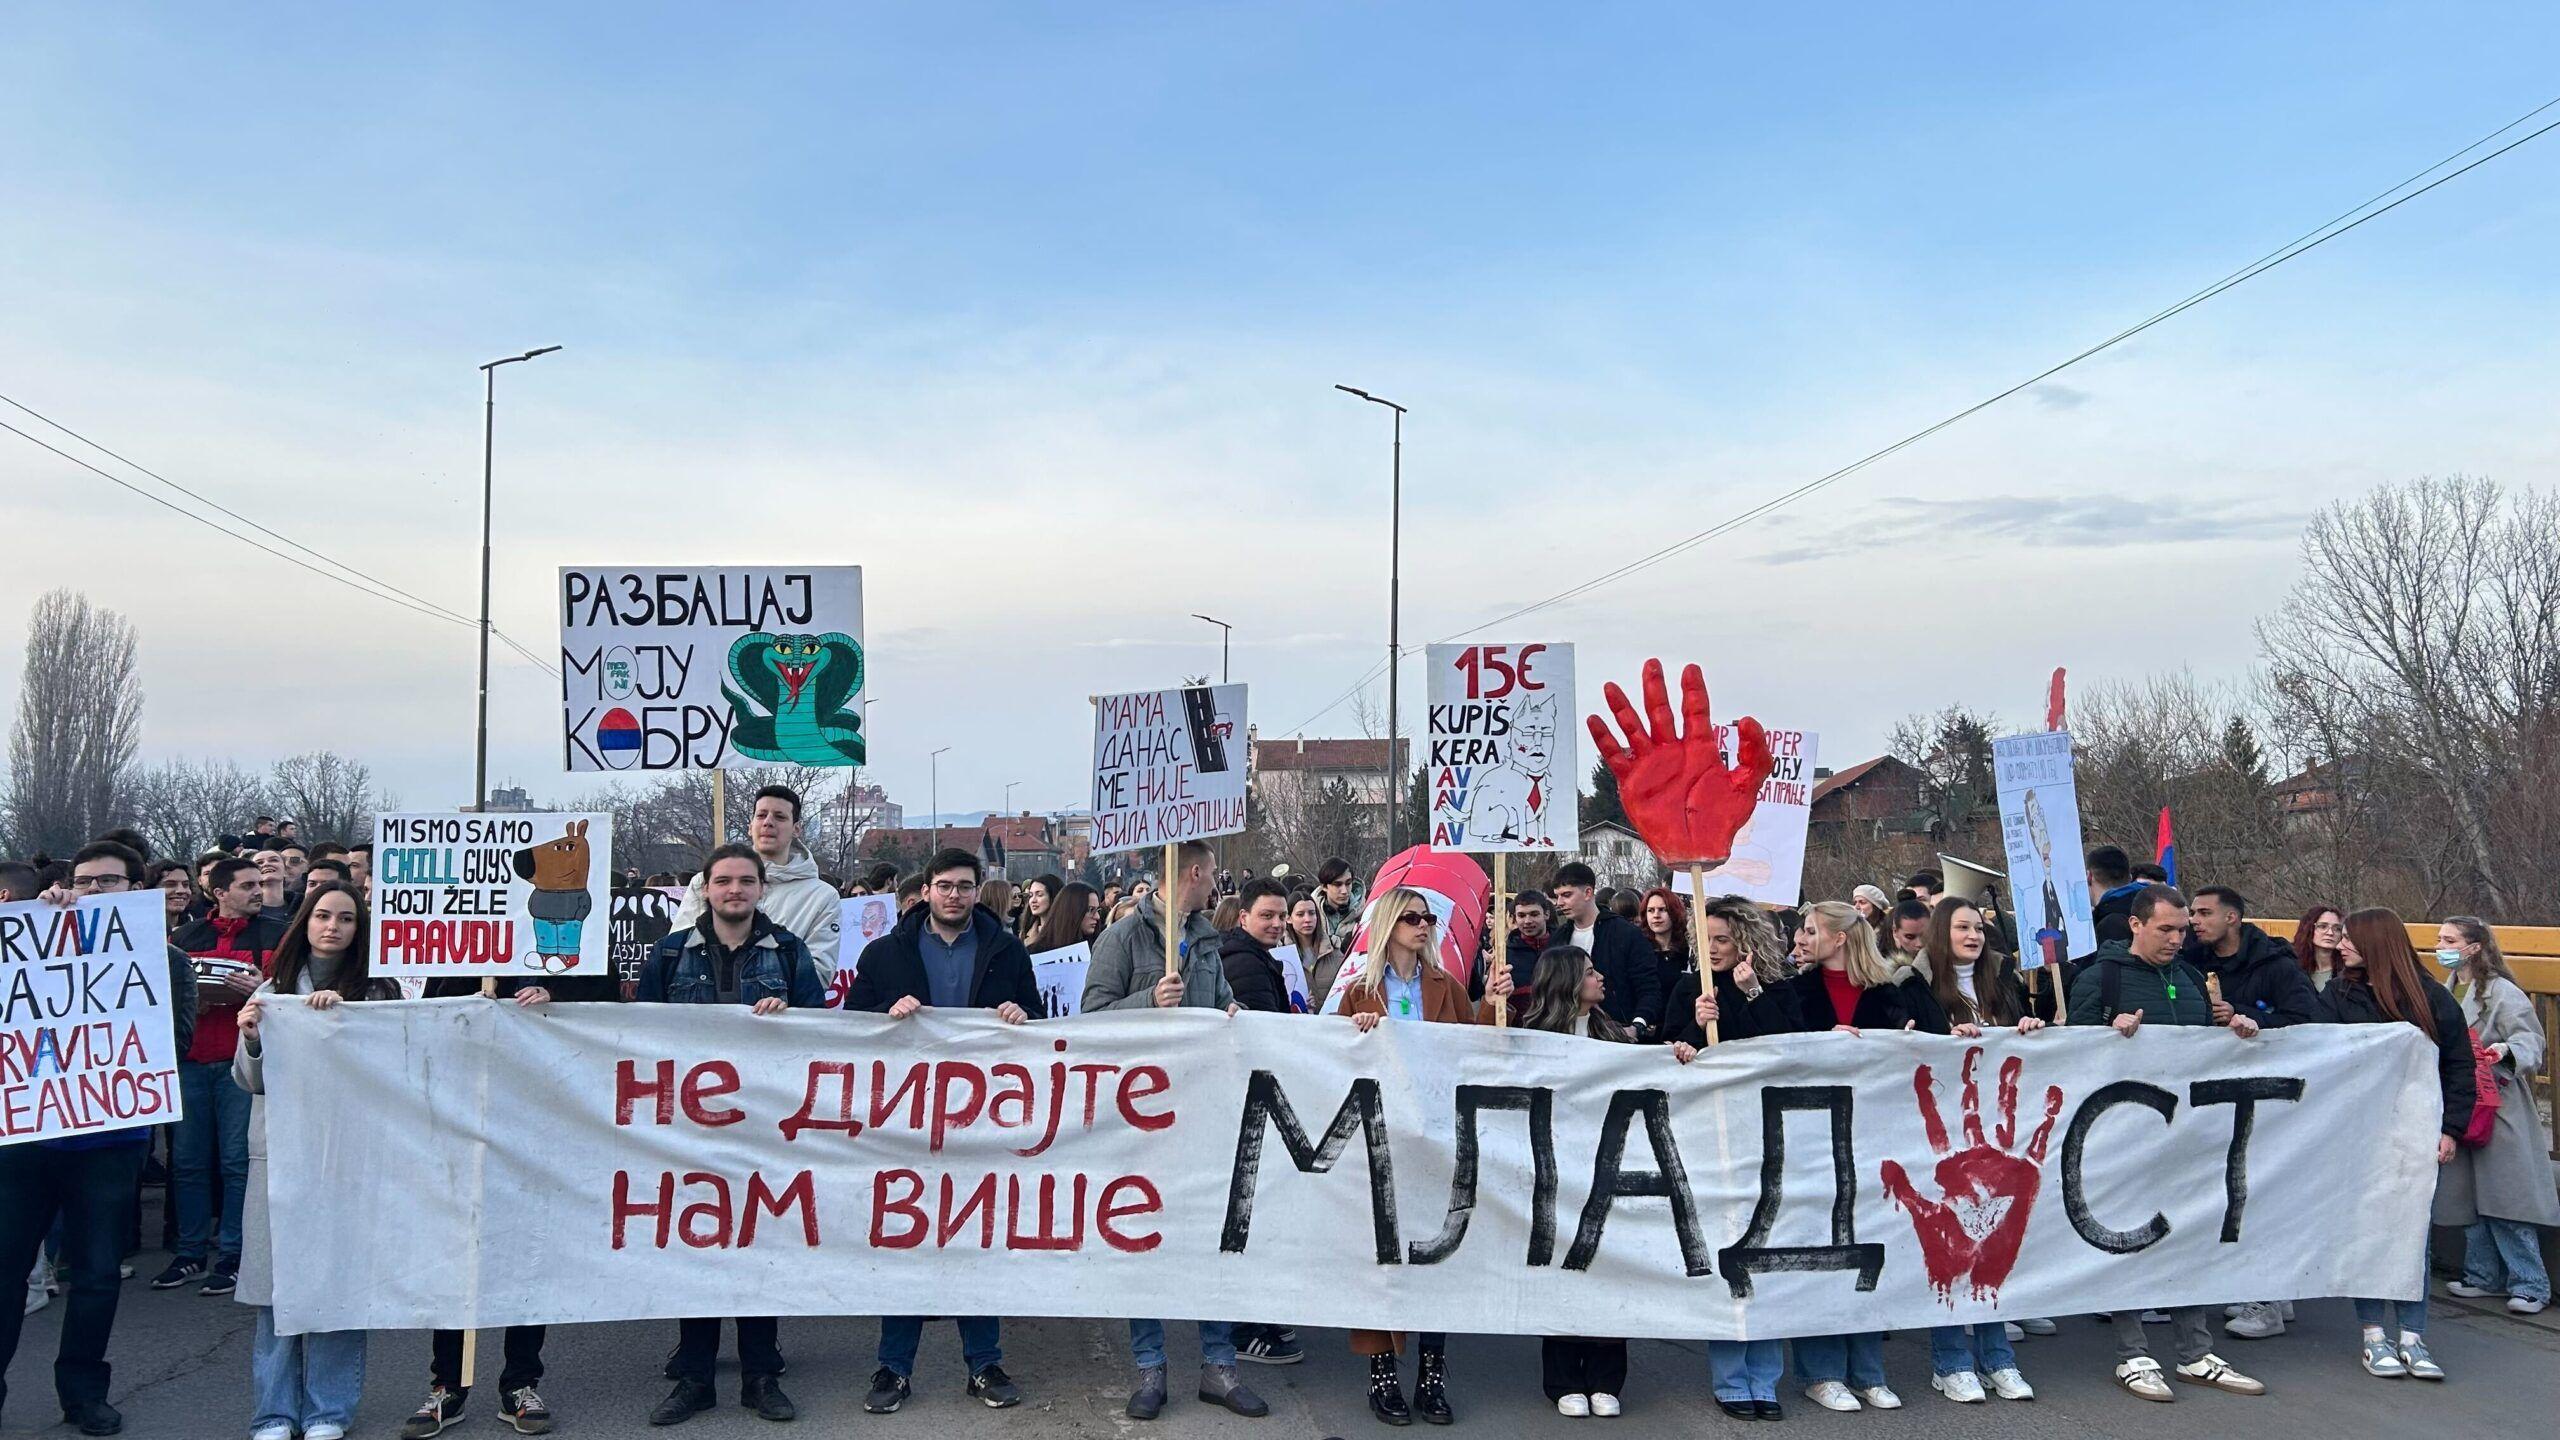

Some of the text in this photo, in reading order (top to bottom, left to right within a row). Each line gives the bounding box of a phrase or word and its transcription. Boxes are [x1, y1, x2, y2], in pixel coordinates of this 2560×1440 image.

[565, 572, 812, 631] РАЗБАЦАЈ
[1454, 644, 1547, 699] 15€
[1101, 692, 1171, 731] МАМА,
[1099, 727, 1182, 771] ДАНАС
[1431, 739, 1500, 767] KERA
[1097, 764, 1194, 811] МЕ НИЈЕ
[1436, 767, 1472, 788] AV
[1434, 790, 1467, 811] AV
[383, 819, 533, 844] MI SMO SAMO
[1092, 797, 1246, 850] УБИЛА КОРУПЦИЈА
[1433, 823, 1464, 846] AV
[382, 848, 512, 884] CHILL GUYS
[381, 885, 507, 915] KOJI ŽELE
[380, 920, 513, 964] PRAVDU
[0, 961, 158, 1024] AJKA
[0, 1069, 175, 1137] EALNOST
[616, 1039, 1176, 1157] не дирајте
[612, 1168, 1163, 1252] нам више
